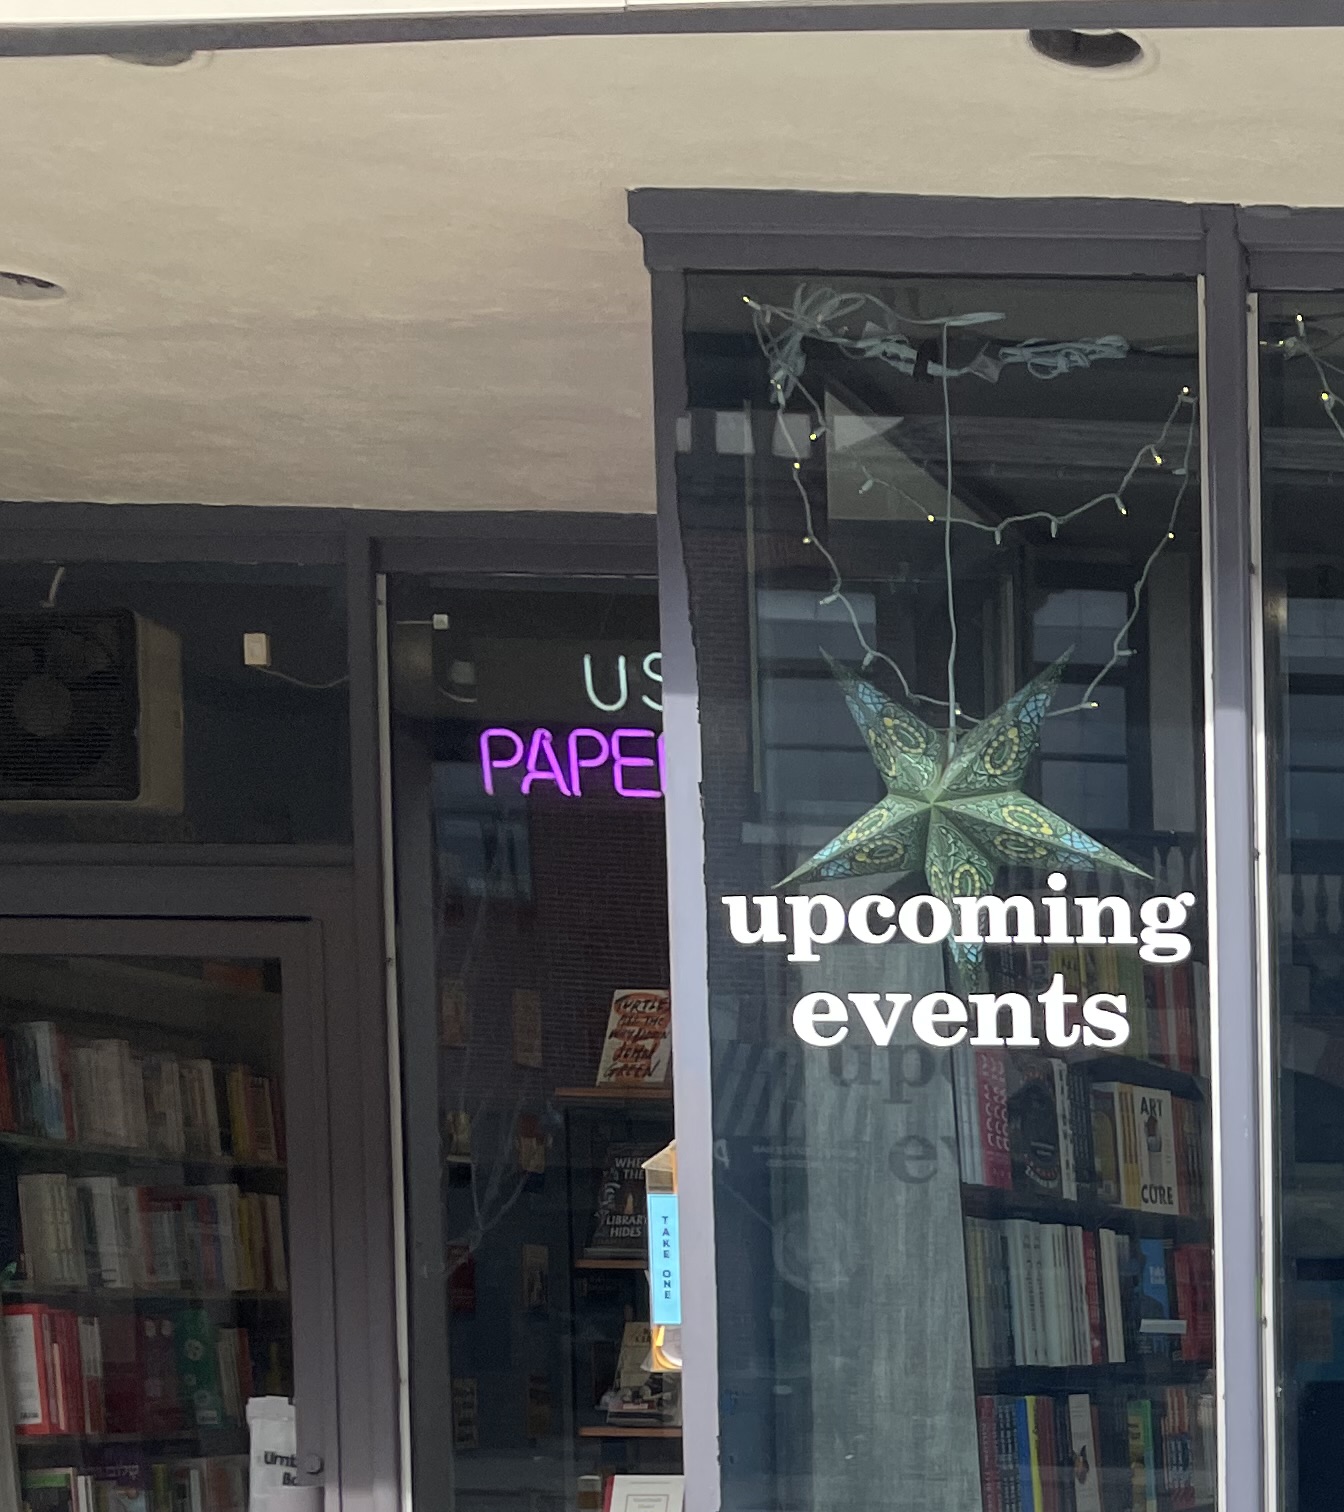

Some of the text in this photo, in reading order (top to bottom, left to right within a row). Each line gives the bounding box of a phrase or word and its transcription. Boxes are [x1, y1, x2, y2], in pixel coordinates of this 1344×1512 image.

[479, 728, 667, 798] PAPE
[722, 872, 1196, 963] upcoming
[792, 973, 1130, 1047] events
[1140, 1097, 1163, 1116] ART
[1141, 1185, 1174, 1205] CURE
[610, 1227, 642, 1238] HIDES
[661, 1215, 671, 1259] TAKE
[661, 1269, 672, 1299] ONE
